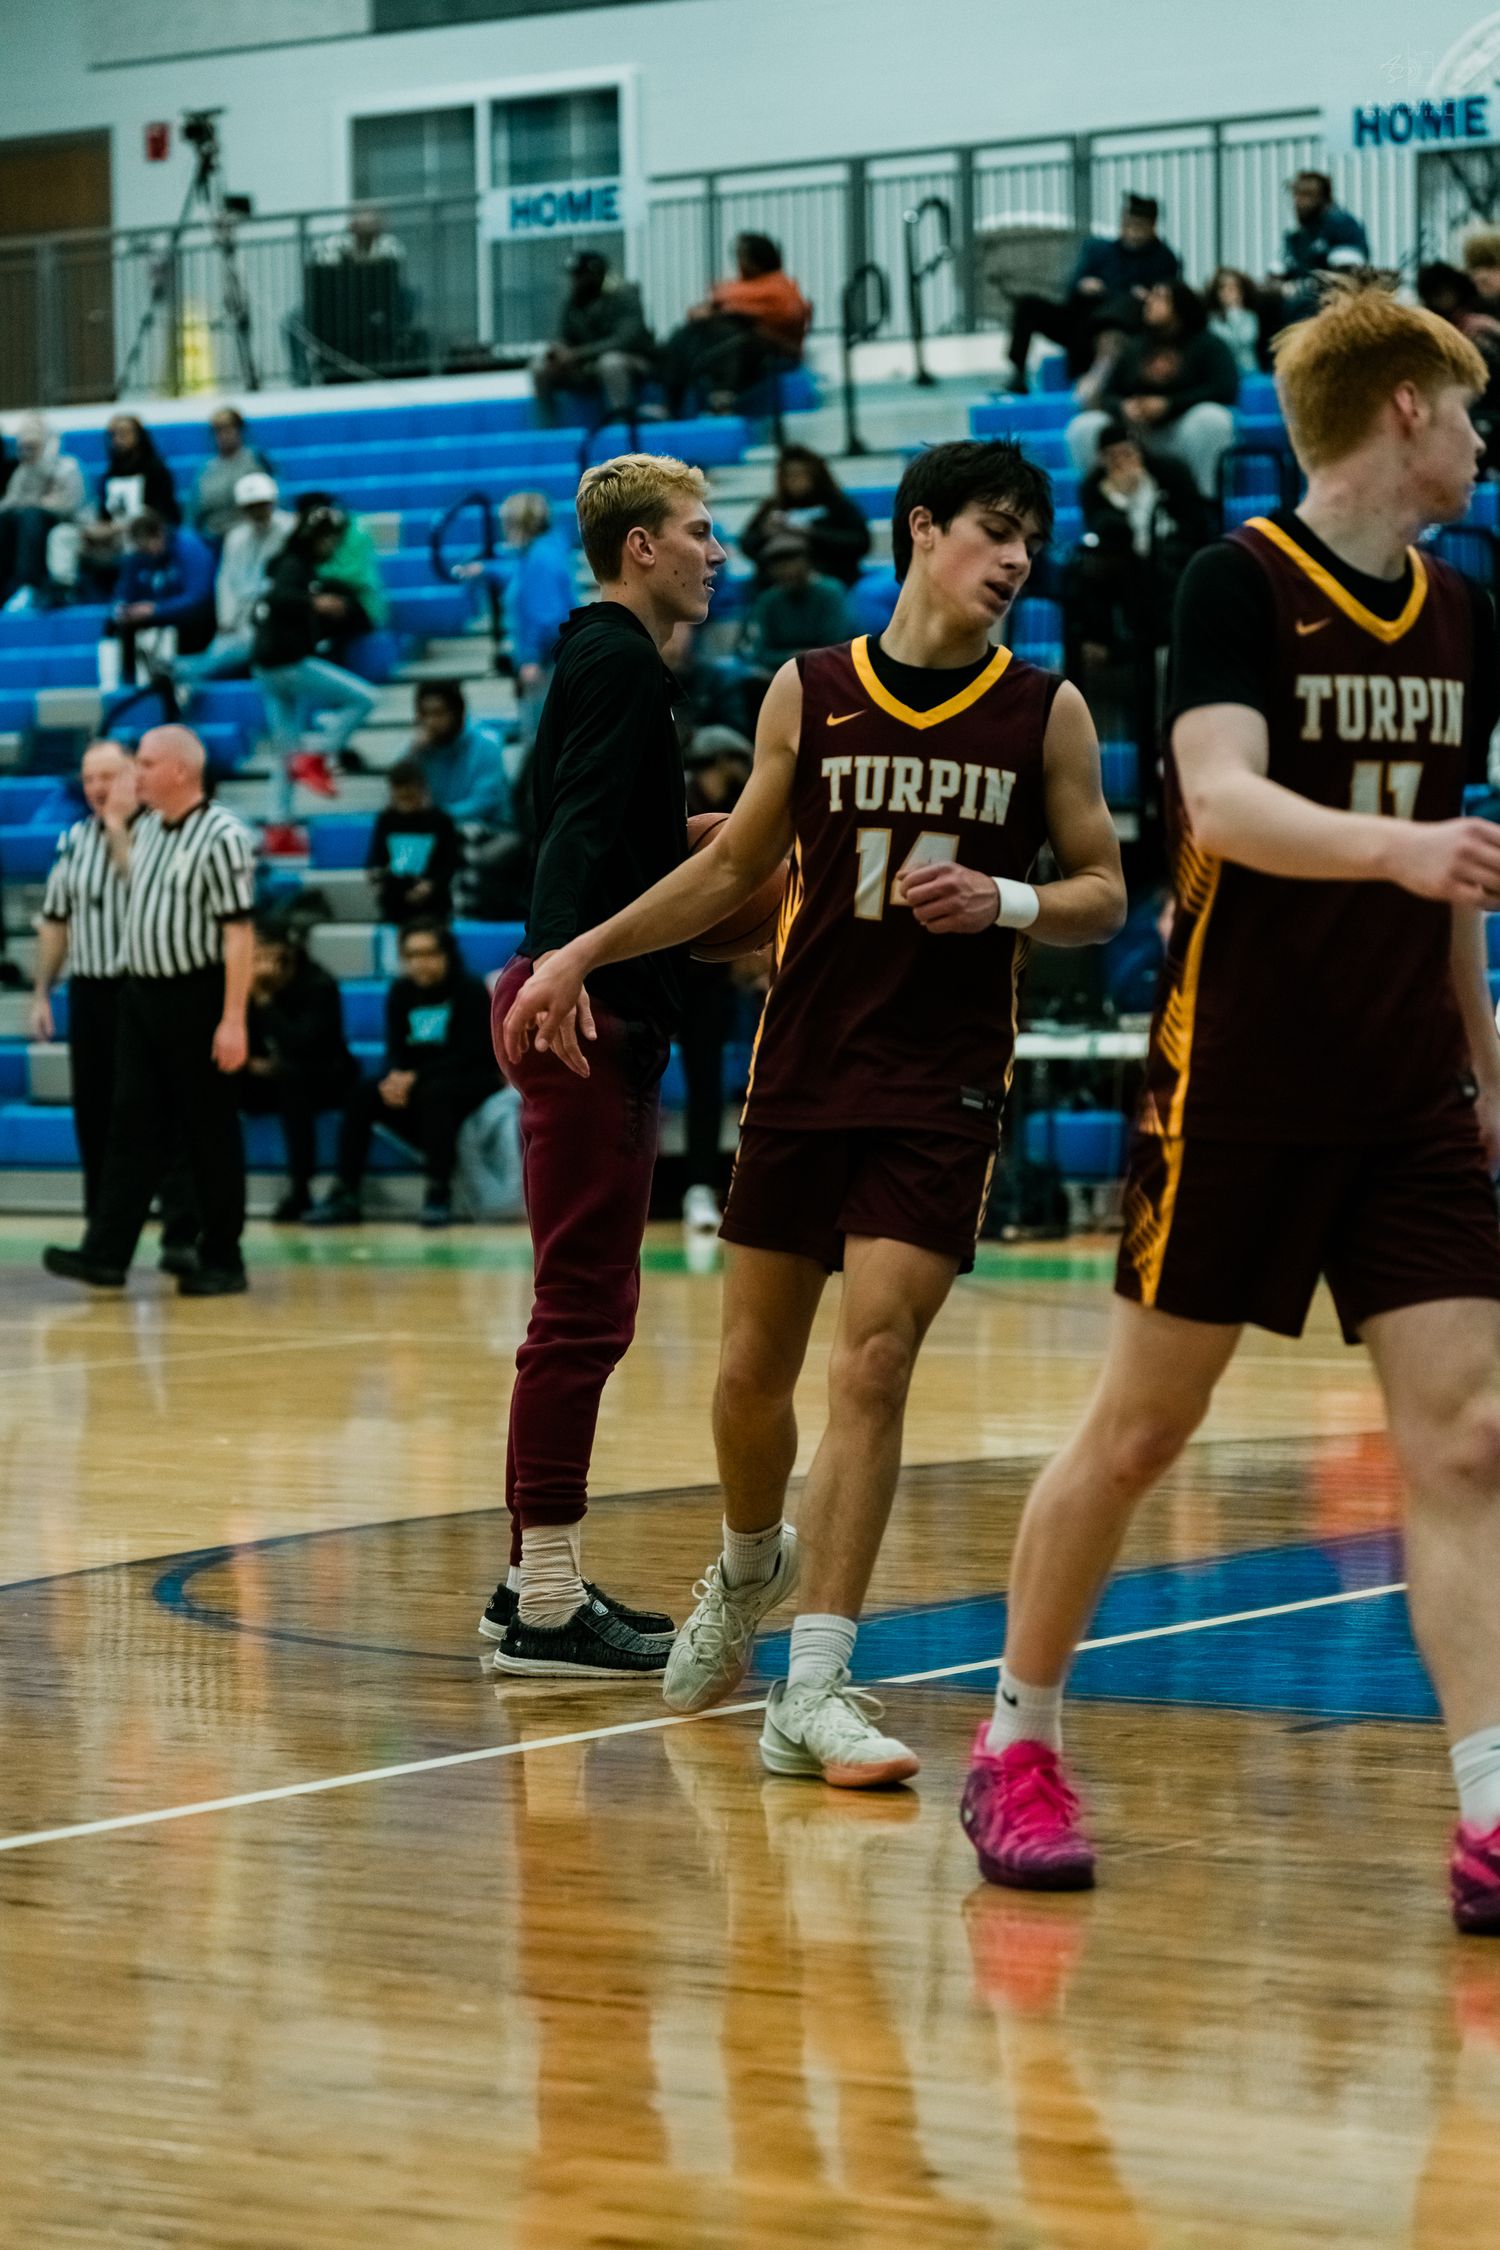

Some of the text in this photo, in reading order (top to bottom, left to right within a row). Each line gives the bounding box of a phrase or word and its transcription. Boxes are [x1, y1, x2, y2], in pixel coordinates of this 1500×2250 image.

[1353, 96, 1488, 147] HOME
[511, 186, 619, 230] HOME
[1296, 674, 1464, 747] TURPIN
[821, 755, 1017, 826] TURPIN
